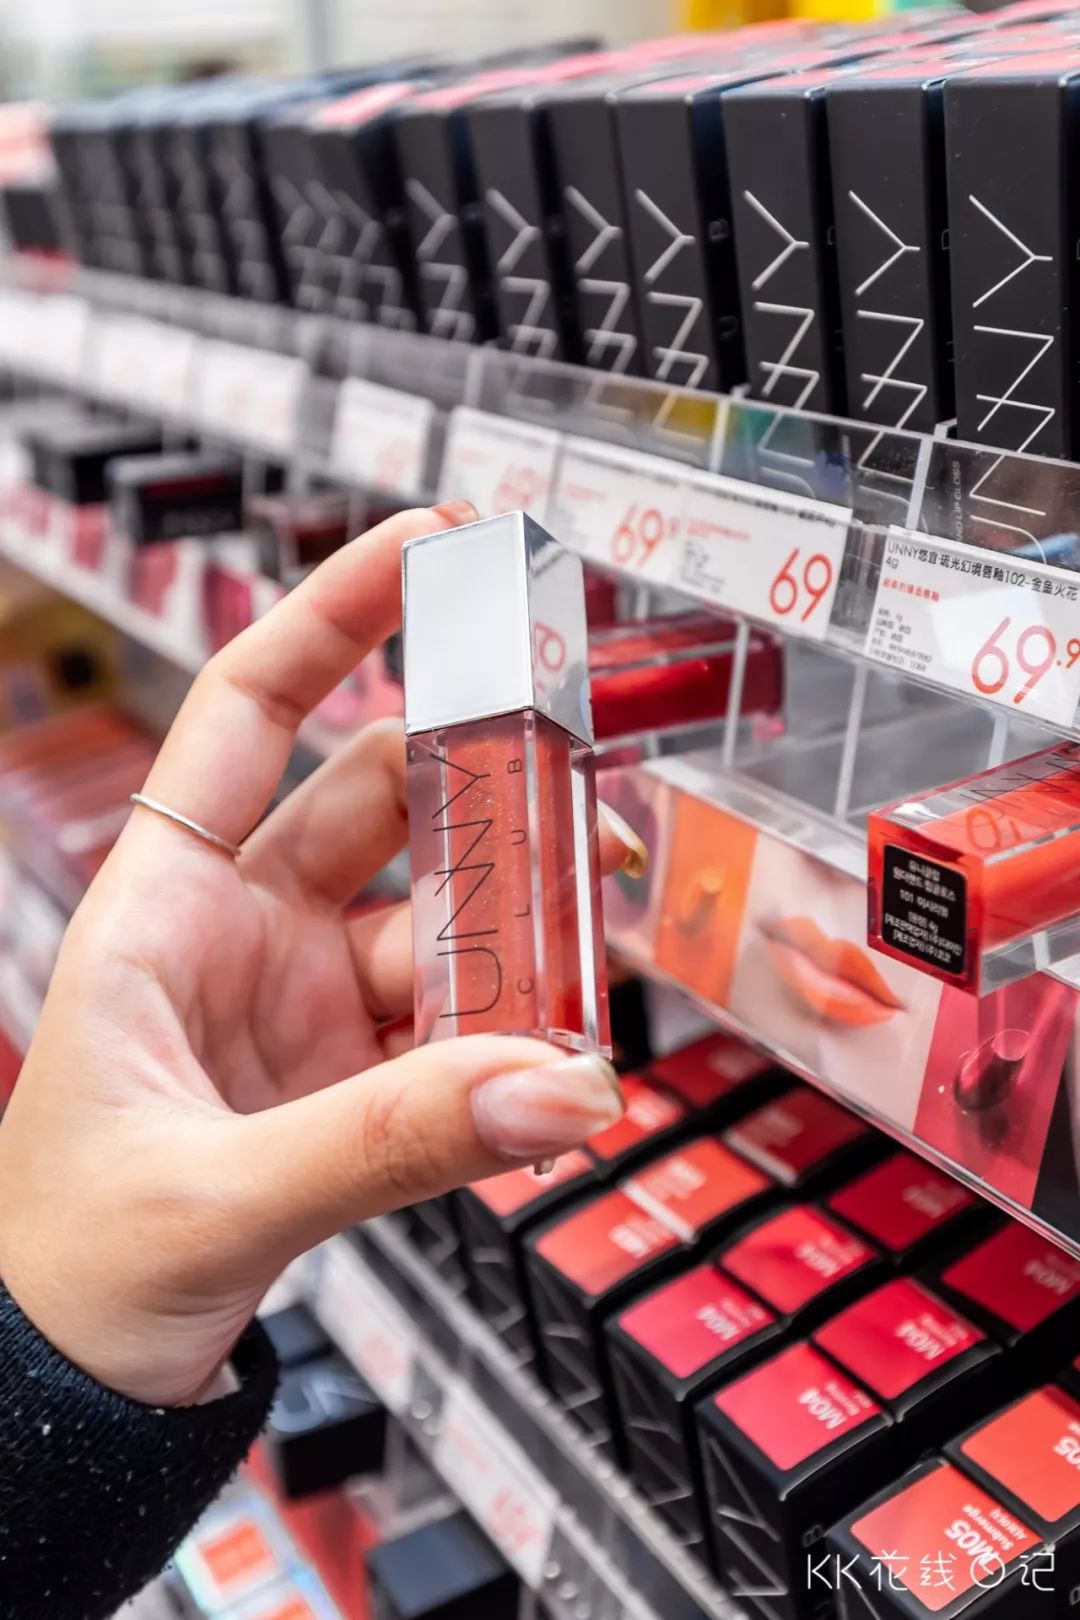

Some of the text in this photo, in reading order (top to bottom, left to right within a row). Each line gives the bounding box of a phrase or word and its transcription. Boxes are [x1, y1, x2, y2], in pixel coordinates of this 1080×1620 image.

[884, 555, 899, 570] 4g
[429, 751, 501, 1019] UNNY
[797, 1387, 848, 1430] M04
[1053, 1435, 1080, 1471] 05
[944, 1519, 999, 1566] M05
[961, 1503, 1015, 1551] Submerge
